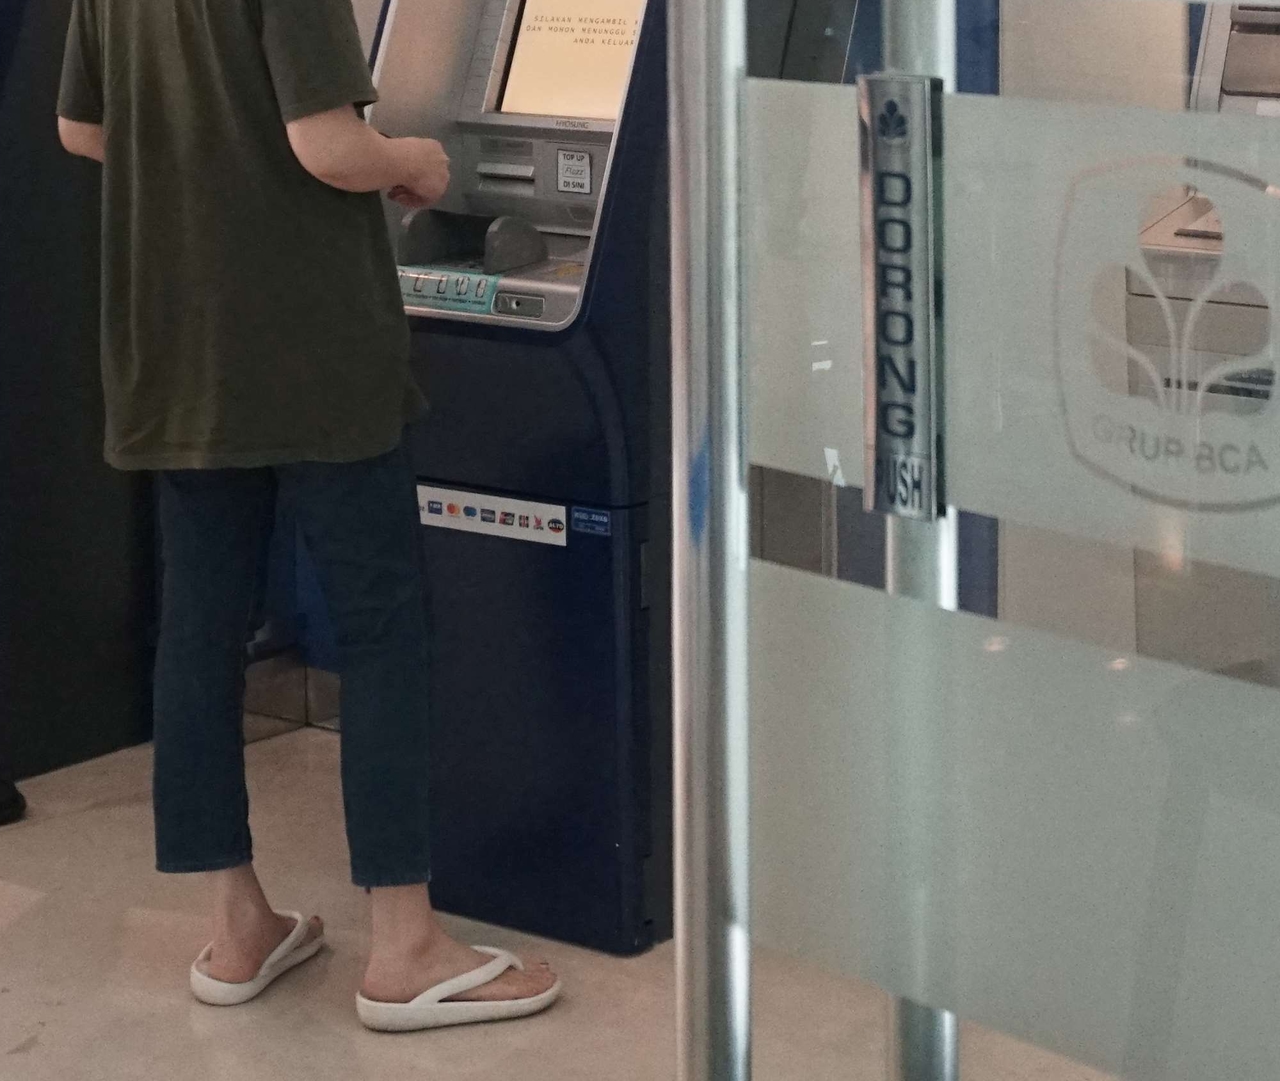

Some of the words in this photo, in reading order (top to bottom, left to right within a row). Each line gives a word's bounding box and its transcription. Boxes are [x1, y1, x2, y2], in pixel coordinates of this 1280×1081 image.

[534, 15, 572, 24] SILAKAN
[578, 17, 628, 27] MENGAMBIL
[525, 24, 542, 32] DAN
[548, 26, 576, 34] MOHON
[581, 28, 626, 36] MENUNGGU
[573, 37, 595, 45] ANDA
[562, 153, 575, 161] TOP
[576, 154, 585, 162] UP
[877, 171, 917, 441] DORONG
[1090, 412, 1185, 462] GRUP
[1194, 440, 1269, 475] BCA
